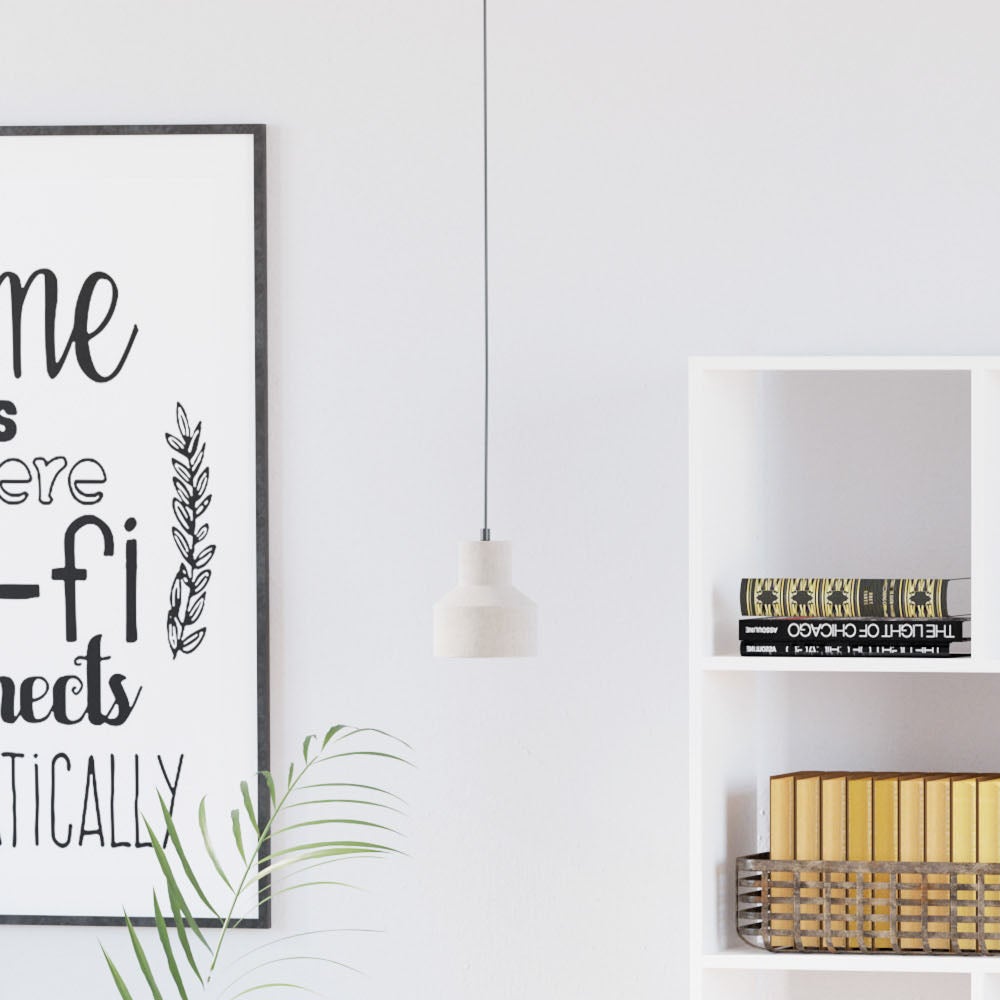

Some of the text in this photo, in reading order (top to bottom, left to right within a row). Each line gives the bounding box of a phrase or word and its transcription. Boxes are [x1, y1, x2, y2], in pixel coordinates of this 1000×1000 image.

[0, 456, 107, 505] ere
[787, 622, 955, 638] THE LIGHT OF CHICAGO
